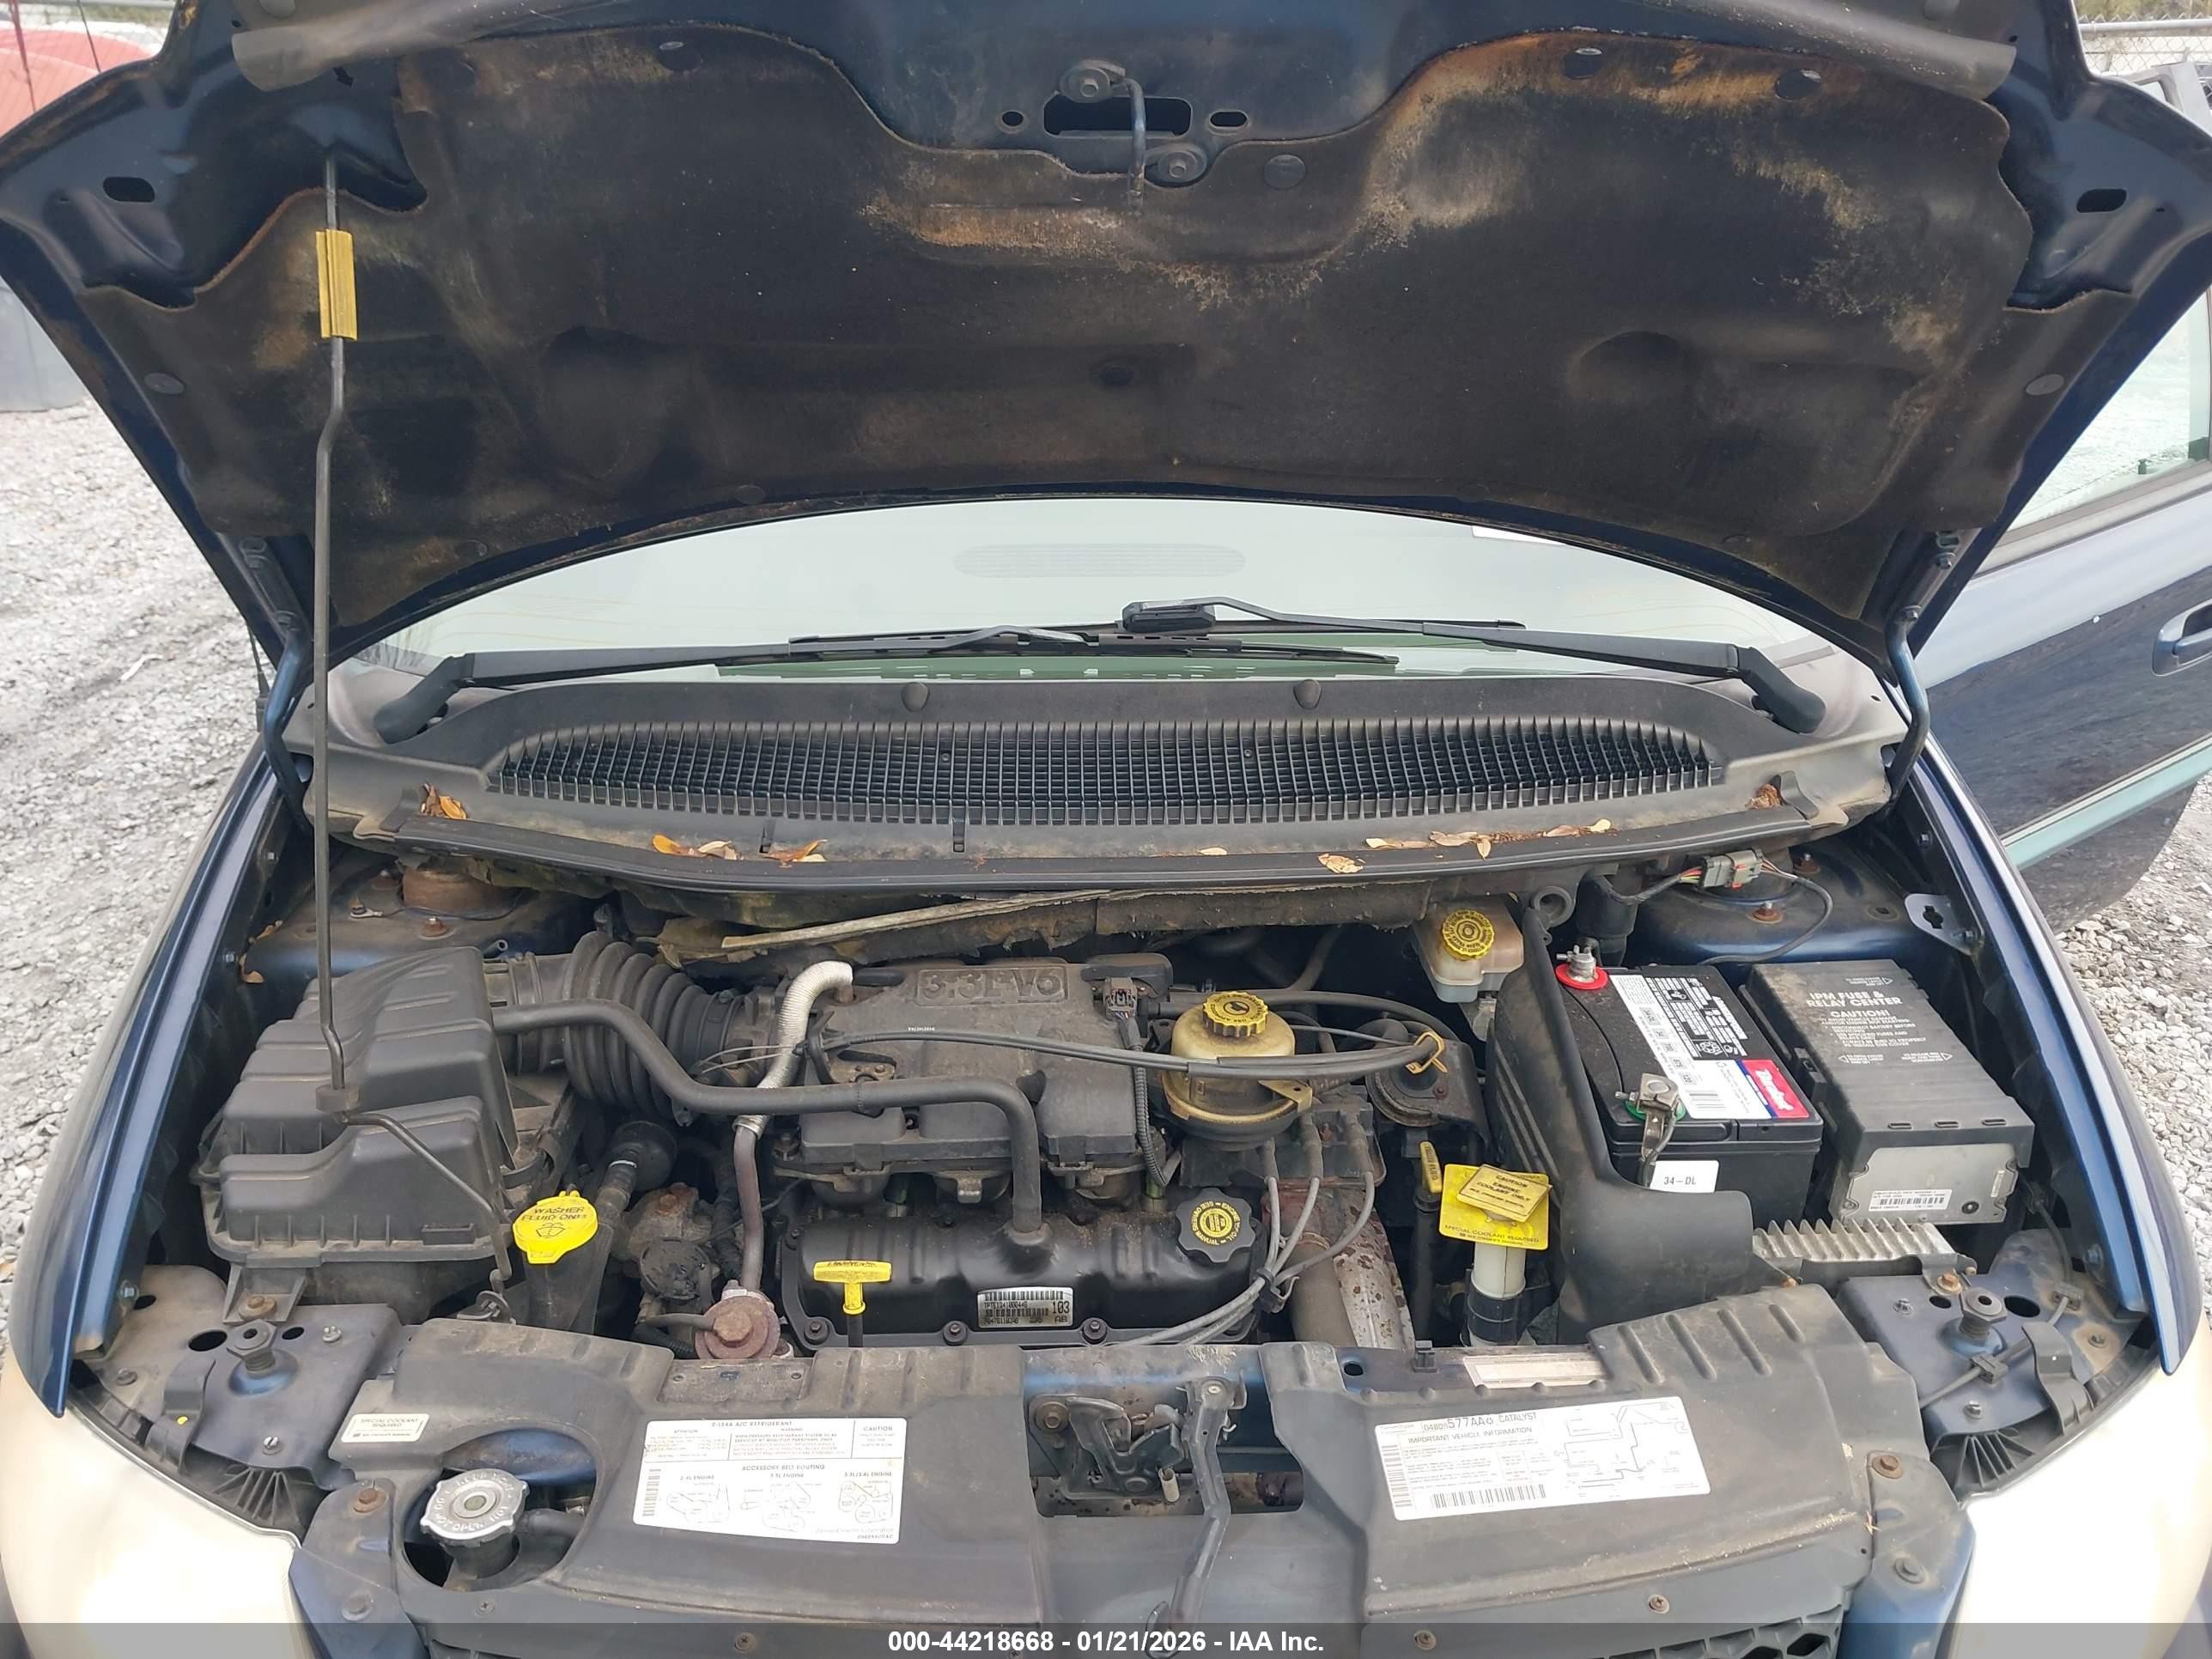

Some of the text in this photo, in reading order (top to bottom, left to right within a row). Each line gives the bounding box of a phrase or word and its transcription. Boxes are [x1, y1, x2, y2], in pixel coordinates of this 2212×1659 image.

[1809, 992, 1836, 1000] IPM
[1873, 990, 1885, 999] &
[1806, 997, 1903, 1007] RELAY CENTER
[1831, 1009, 1891, 1018] CAUTION!
[1444, 1224, 1469, 1233] SPECIAL
[1472, 1230, 1505, 1238] COOLANT
[1052, 1300, 1070, 1314] 103
[1498, 1412, 1537, 1423] CATALYST
[1407, 1426, 1533, 1443] IMPORTANT VEHICLE INFORMATION
